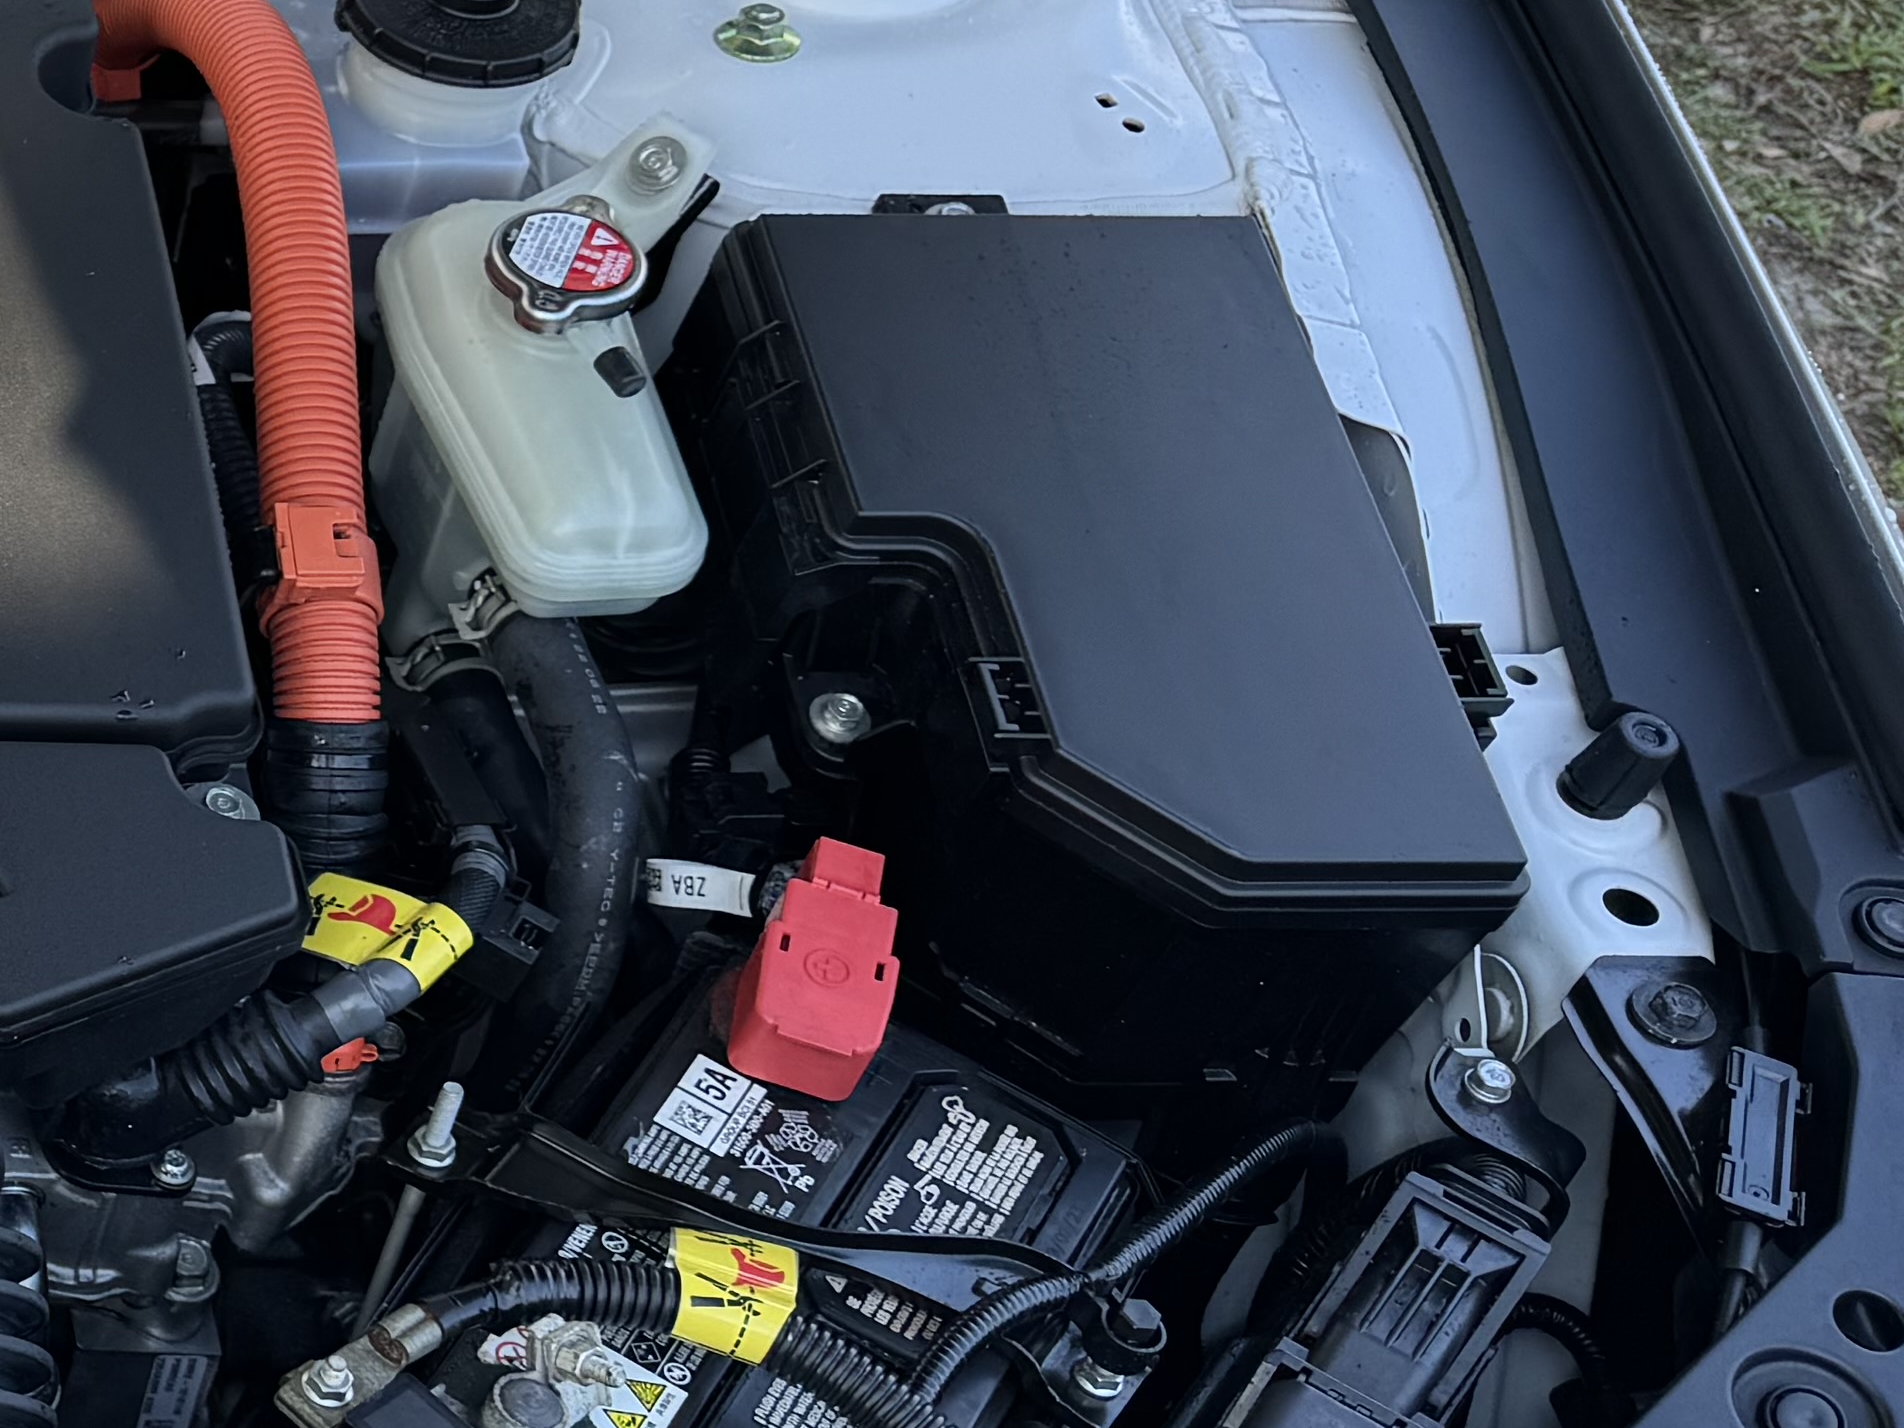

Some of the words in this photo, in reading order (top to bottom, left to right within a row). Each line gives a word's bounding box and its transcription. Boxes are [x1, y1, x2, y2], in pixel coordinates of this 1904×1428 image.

[671, 874, 706, 897] ZBA
[694, 1067, 738, 1102] 5A
[721, 1119, 741, 1144] GROUP
[794, 1171, 816, 1193] Pb
